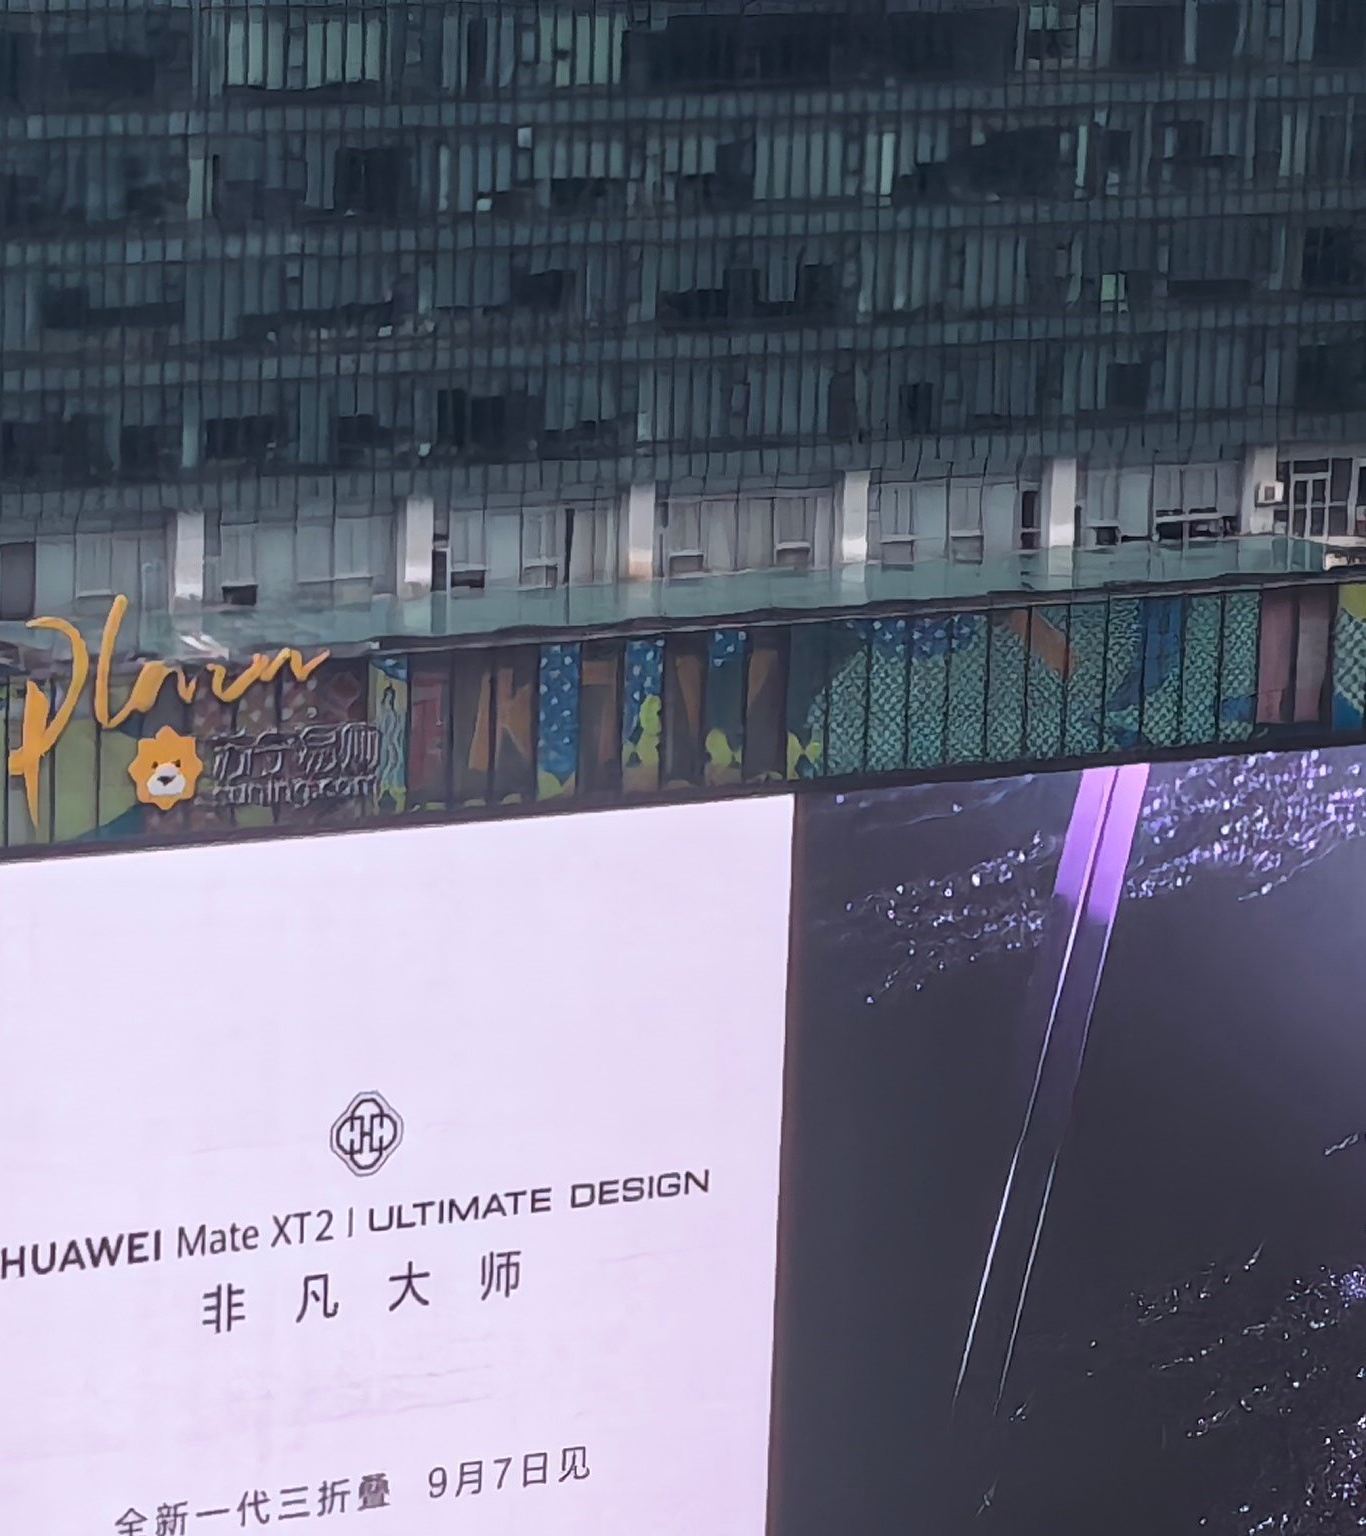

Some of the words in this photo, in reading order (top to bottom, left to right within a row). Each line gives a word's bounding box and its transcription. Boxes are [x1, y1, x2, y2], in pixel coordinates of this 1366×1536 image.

[0, 1230, 162, 1280] HUAWEI
[176, 1219, 260, 1257] Mate
[271, 1209, 334, 1247] XT2
[368, 1187, 553, 1233] ULTIMATE
[570, 1168, 711, 1209] DESIGN
[201, 1250, 523, 1334] 非凡大师
[427, 1445, 592, 1499] 9月7日见
